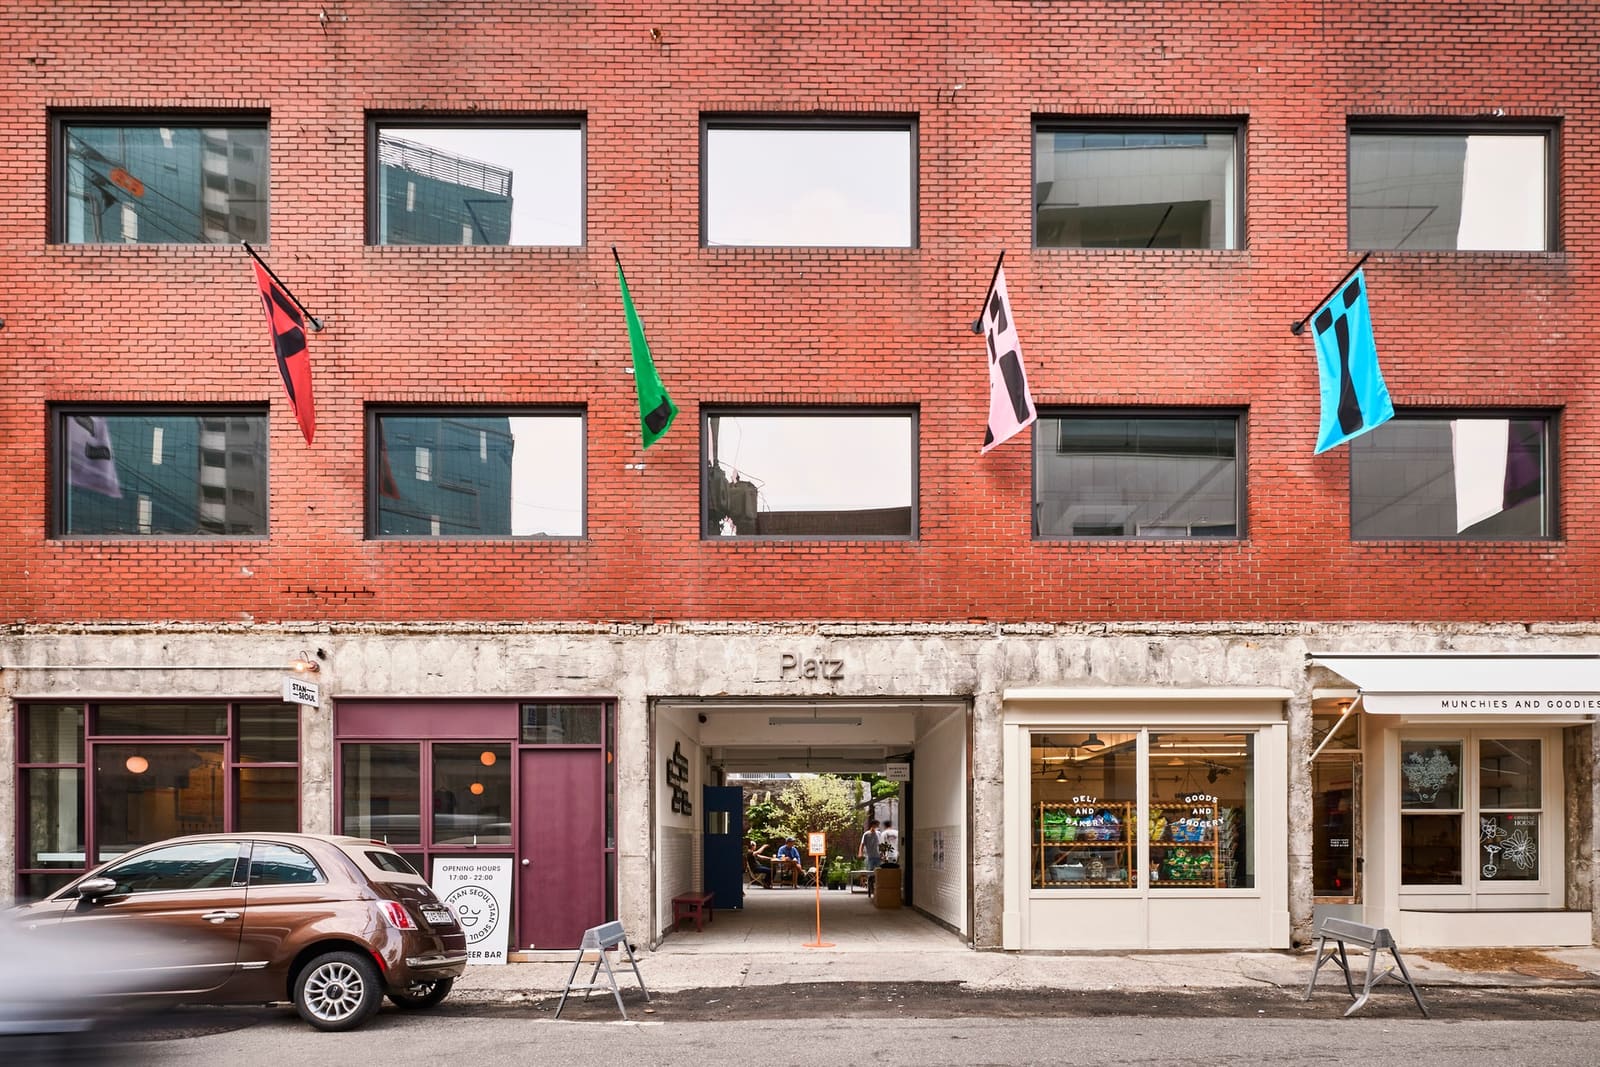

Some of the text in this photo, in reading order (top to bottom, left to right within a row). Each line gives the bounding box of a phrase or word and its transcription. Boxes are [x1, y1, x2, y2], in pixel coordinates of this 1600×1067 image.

[779, 653, 845, 680] Platz
[1441, 700, 1508, 709] MUNCHIES
[1514, 700, 1541, 709] AND
[1072, 795, 1097, 804] DELI
[1185, 794, 1219, 803] GOODS
[1075, 807, 1094, 815] AND
[1192, 807, 1212, 815] AND
[1065, 817, 1104, 827] BAKERY
[1180, 817, 1224, 828] GROCERY
[449, 888, 496, 941] STAN SEOUL STAN SEOUL
[484, 951, 502, 959] BAR
